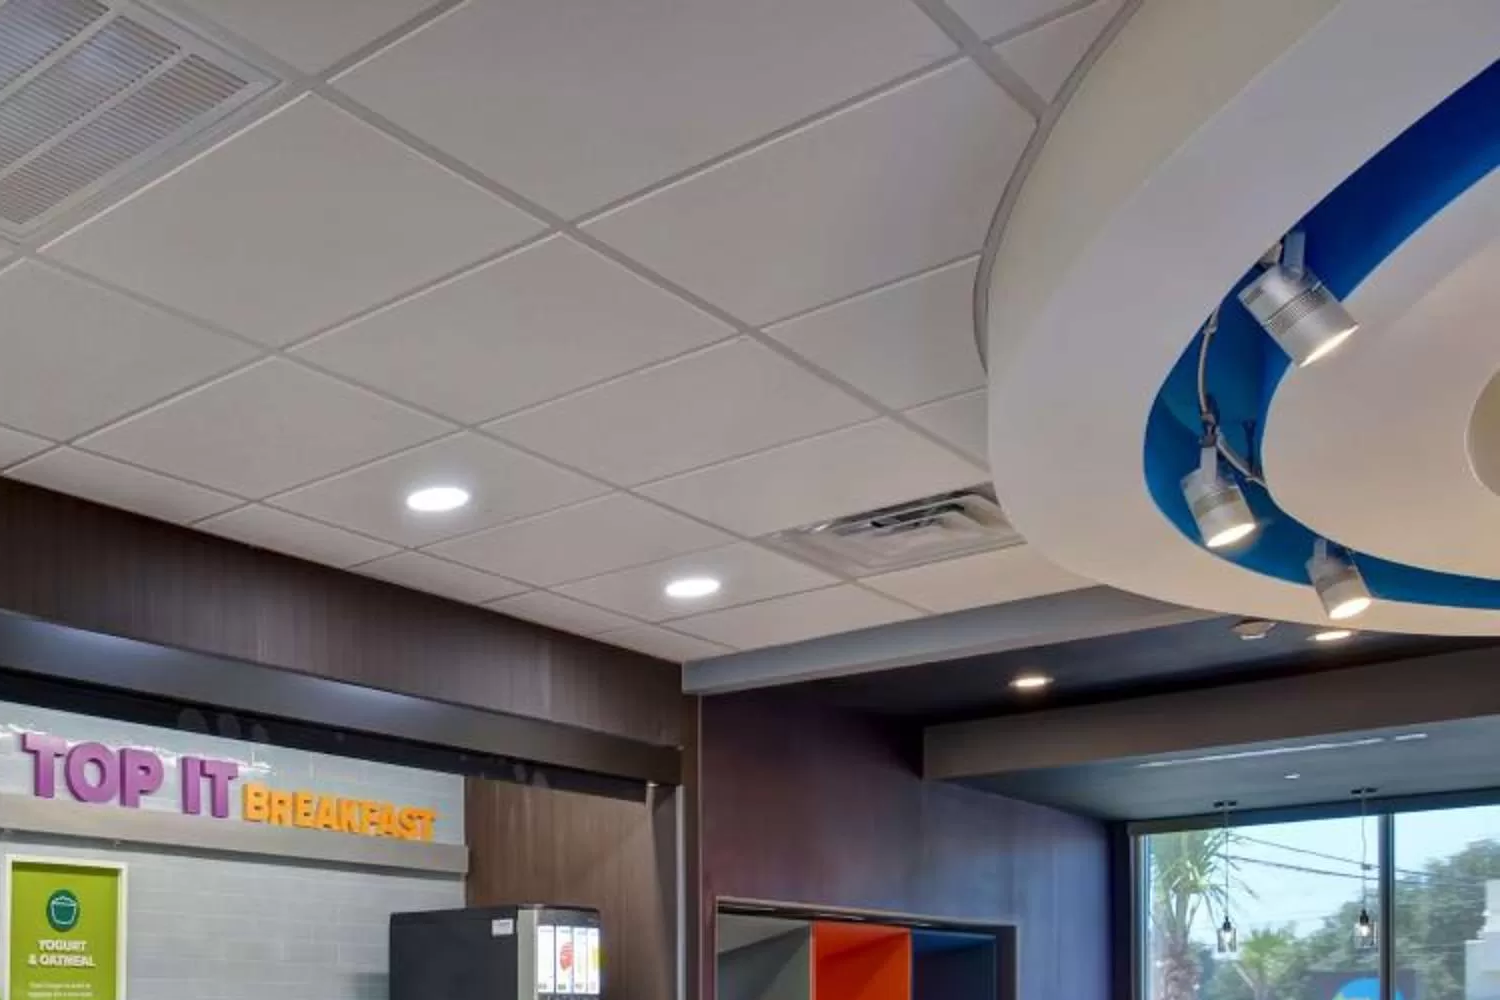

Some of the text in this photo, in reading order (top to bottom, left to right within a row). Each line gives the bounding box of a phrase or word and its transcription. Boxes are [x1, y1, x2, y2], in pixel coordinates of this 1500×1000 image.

[21, 732, 437, 842] TOP IT BREAKFAST
[37, 939, 88, 952] YOGURT
